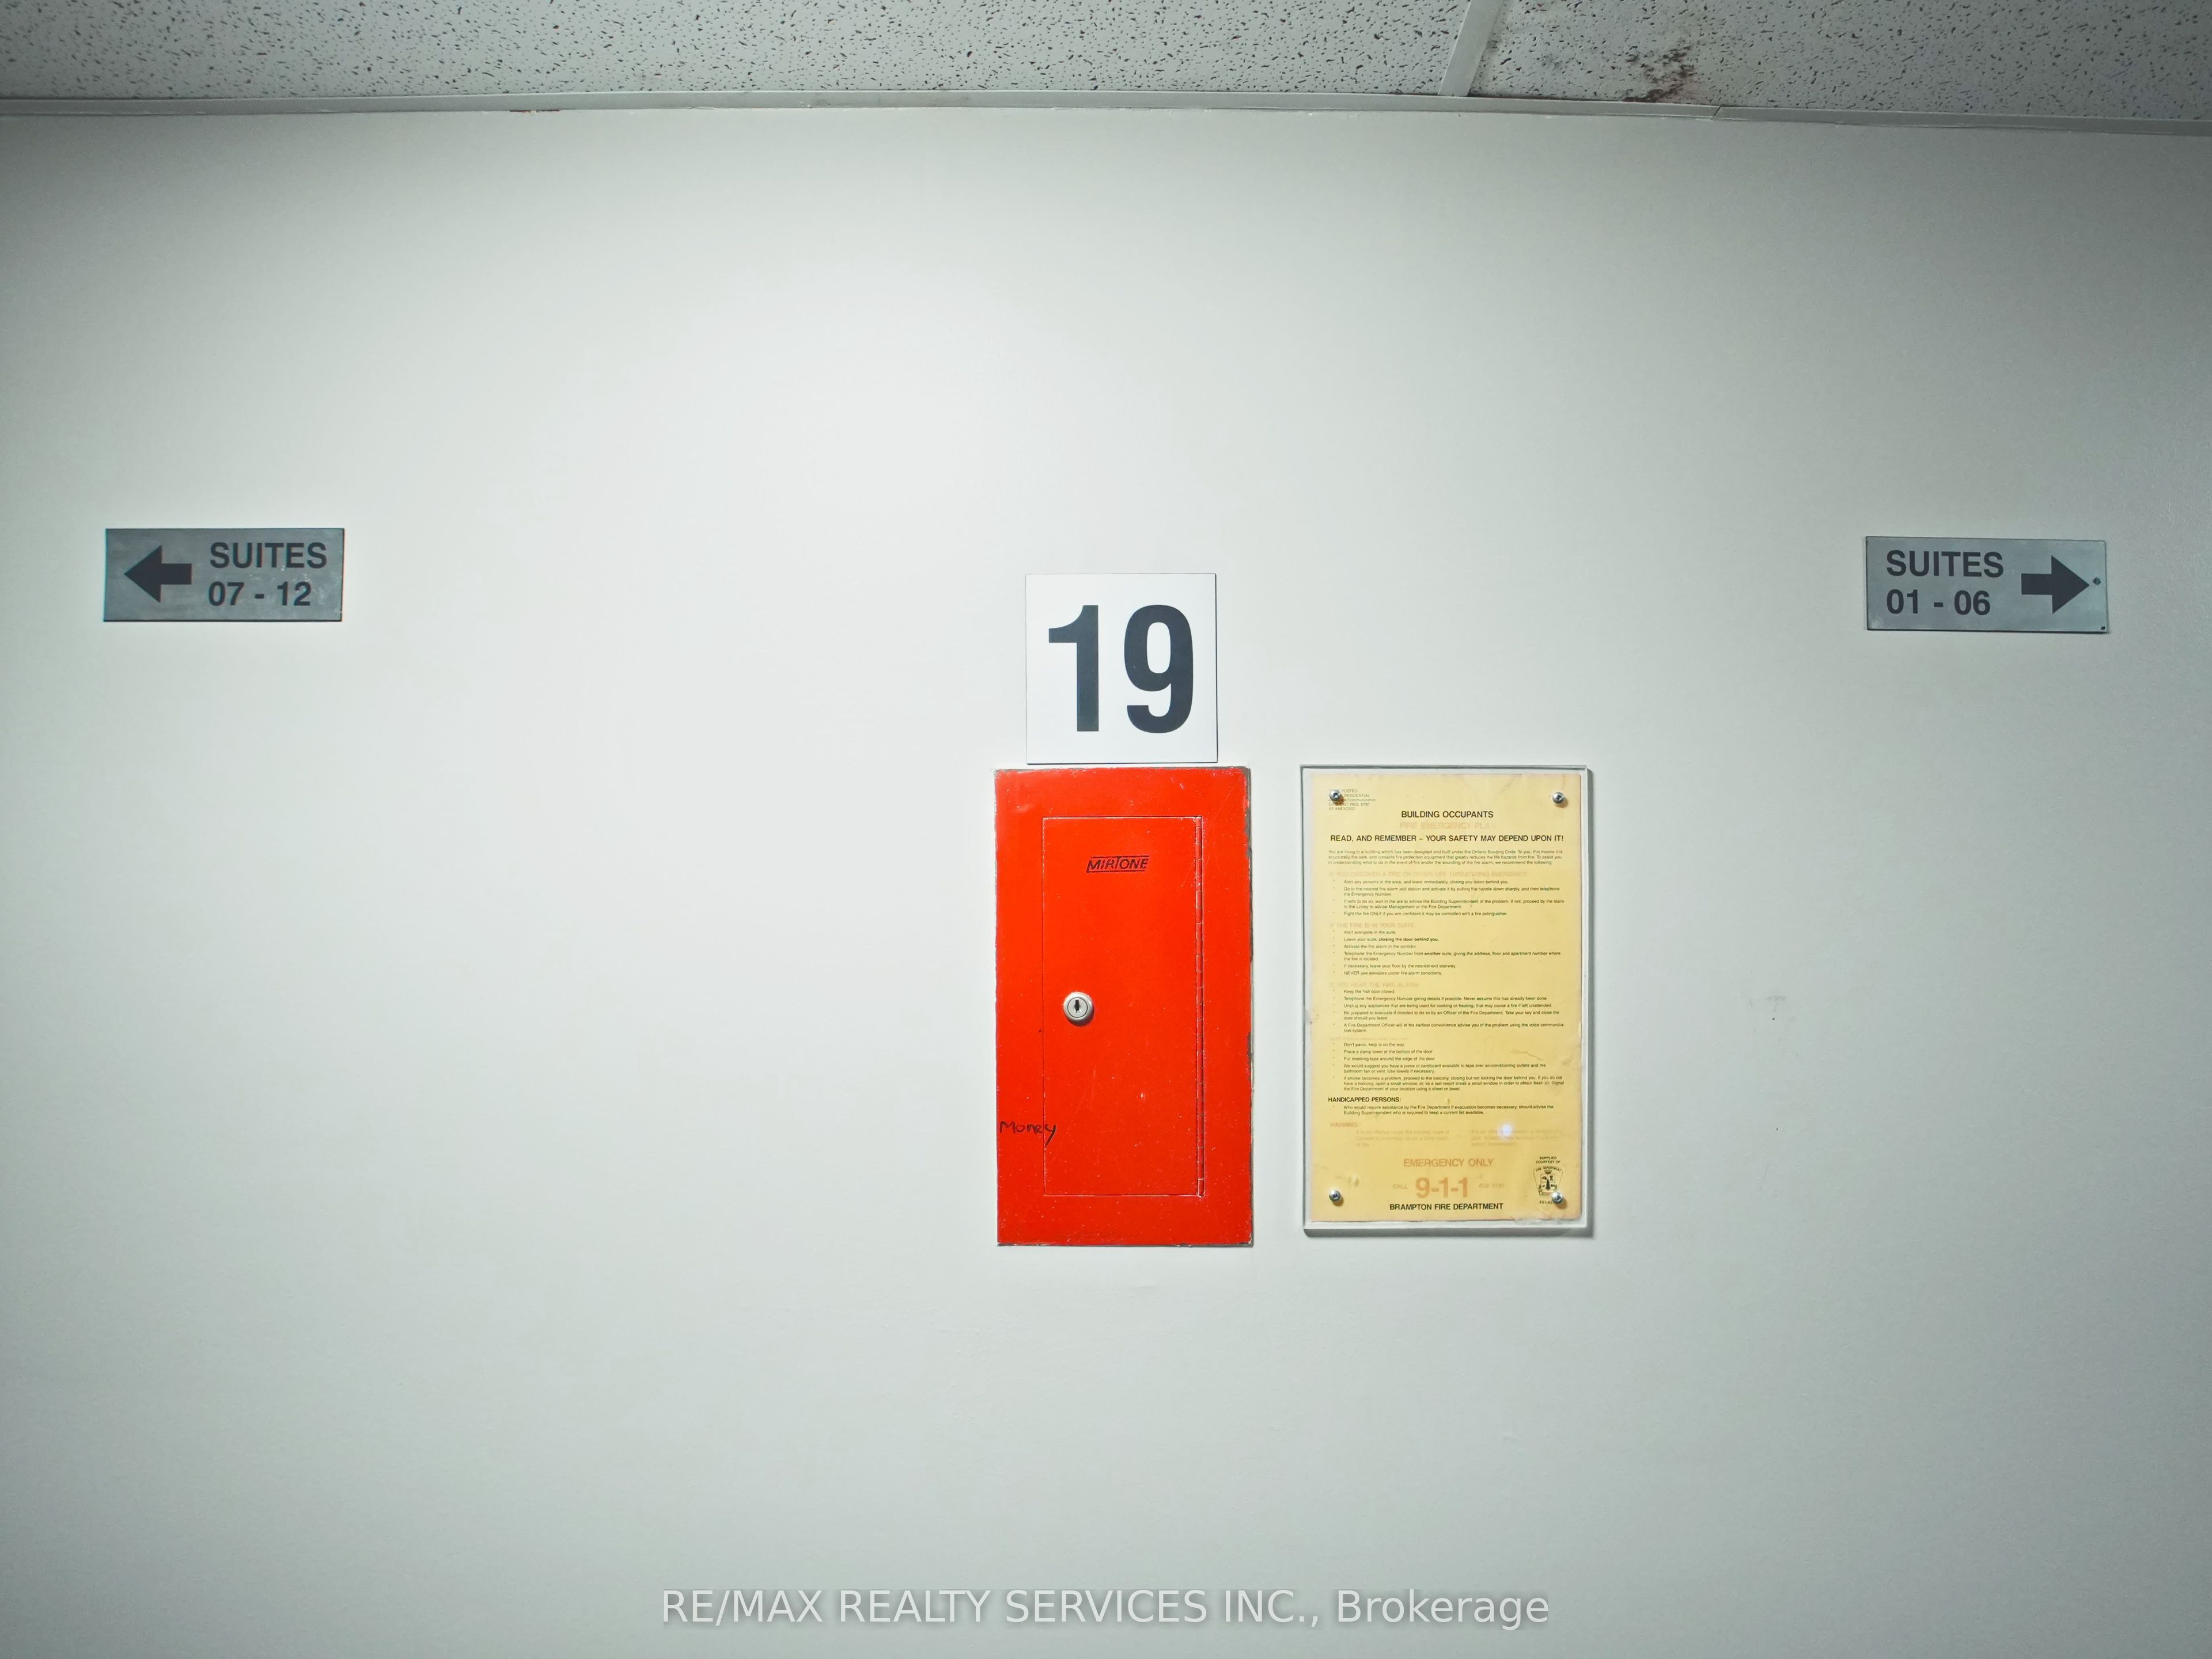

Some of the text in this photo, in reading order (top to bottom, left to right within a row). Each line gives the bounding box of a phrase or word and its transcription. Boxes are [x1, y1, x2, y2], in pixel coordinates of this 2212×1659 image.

[210, 541, 327, 569] SUITES
[1886, 550, 2004, 578] SUITES
[209, 581, 245, 607] 07
[276, 581, 312, 606] 12
[1886, 589, 1919, 614] 01
[1953, 590, 1991, 615] 06
[1048, 604, 1194, 733] 19
[1086, 856, 1149, 873] MIRTONE
[1000, 1121, 1056, 1147] Money
[1403, 1158, 1493, 1167] EMERGENCY ONLY
[1415, 1177, 1468, 1199] 9-1-1
